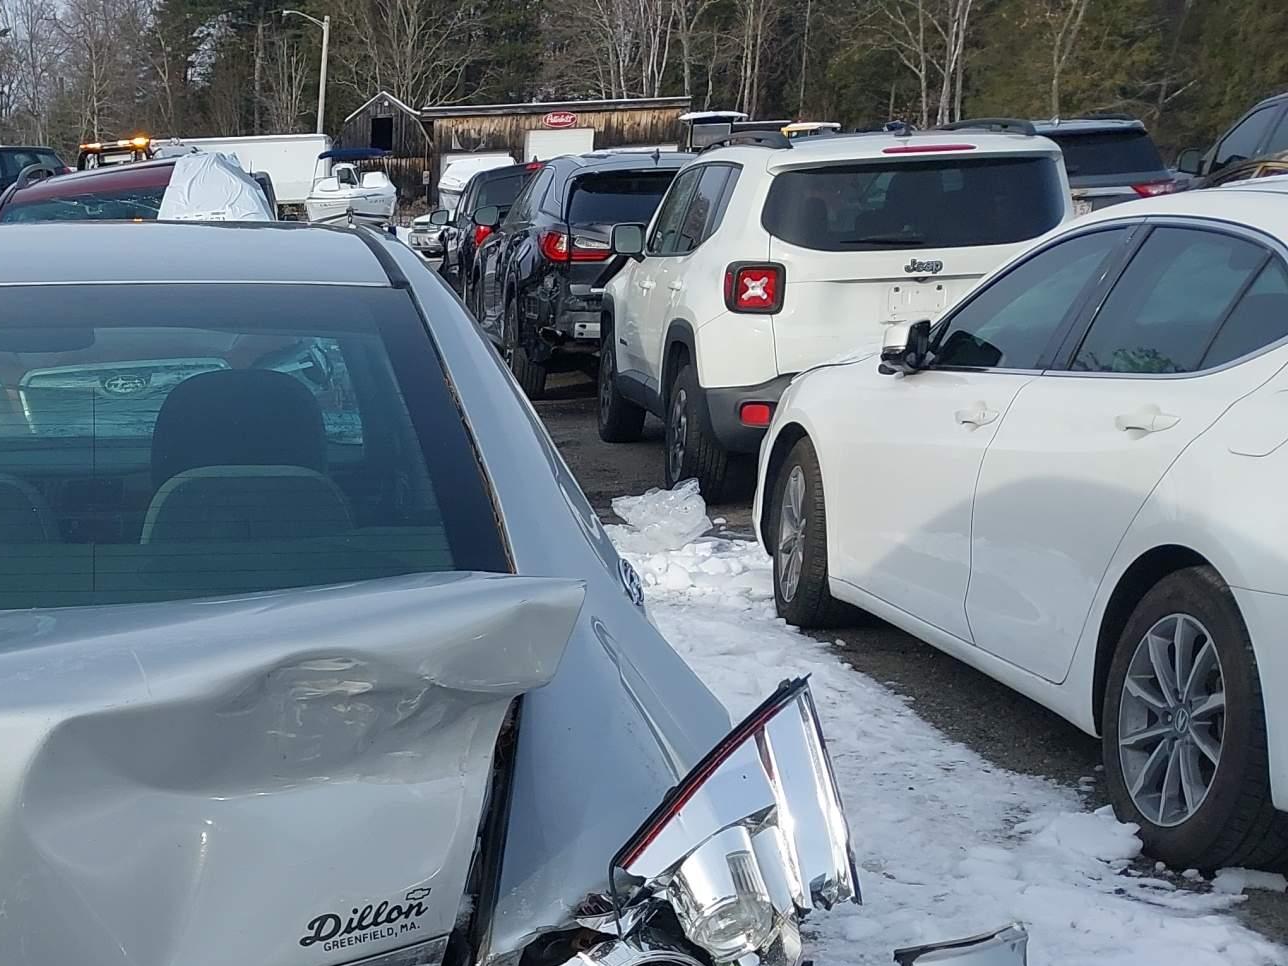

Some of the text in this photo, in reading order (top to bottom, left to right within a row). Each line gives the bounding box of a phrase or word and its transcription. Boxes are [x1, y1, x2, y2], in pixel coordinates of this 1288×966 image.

[904, 258, 943, 274] Jeep
[299, 900, 429, 947] Dillon
[323, 920, 421, 952] GREENFIELD, MA.
